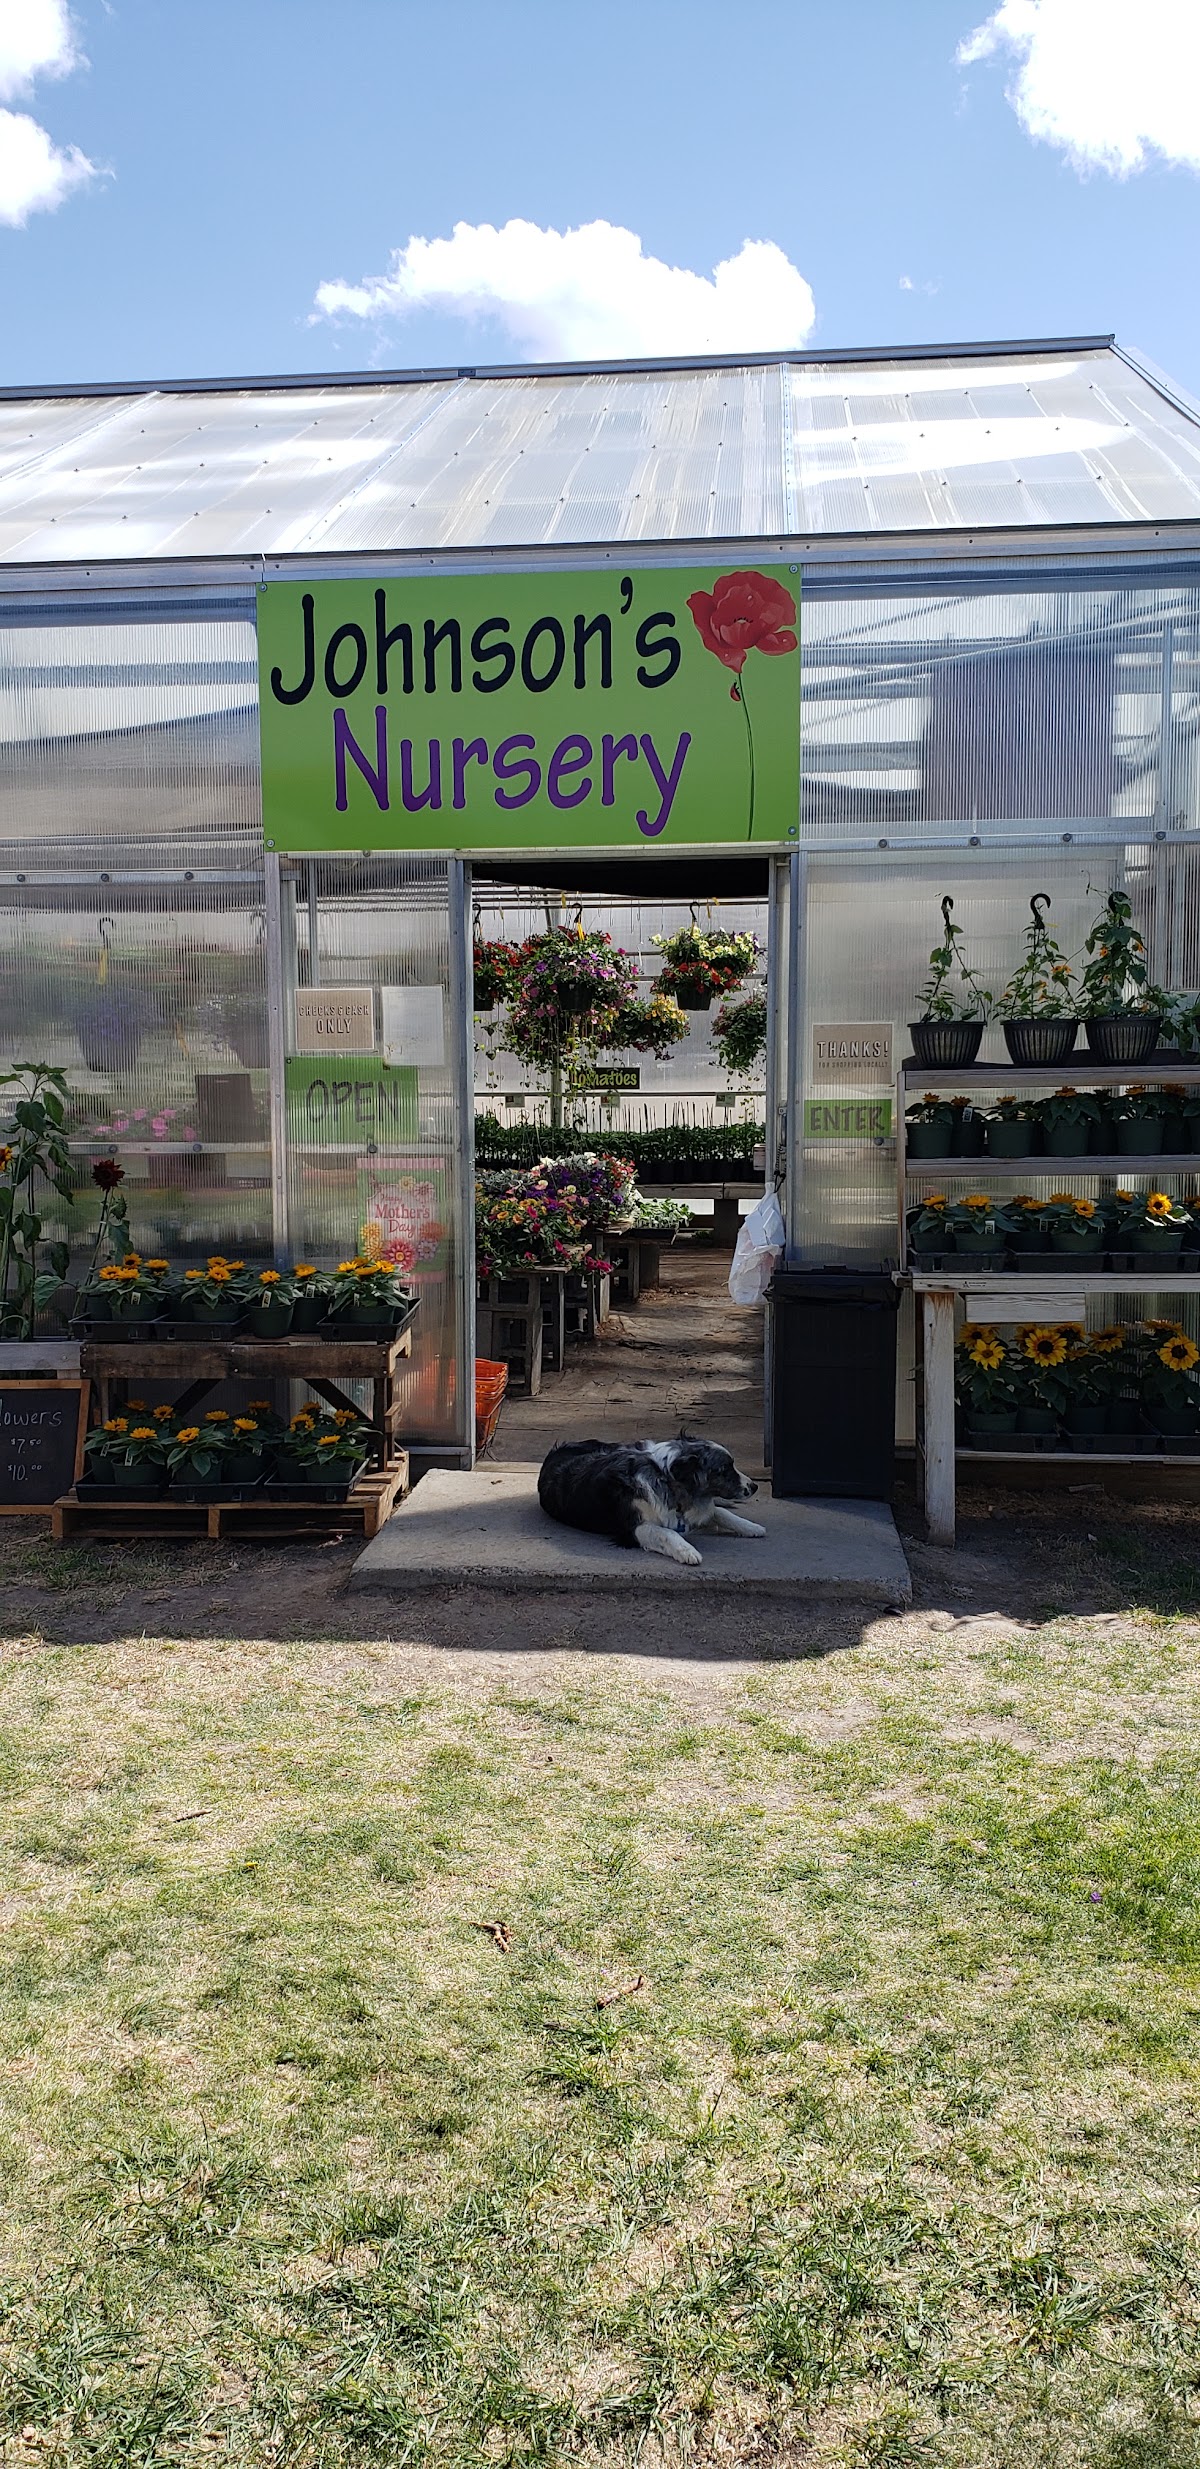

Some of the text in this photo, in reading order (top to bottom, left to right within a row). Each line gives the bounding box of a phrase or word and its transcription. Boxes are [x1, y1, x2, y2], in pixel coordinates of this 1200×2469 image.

[270, 576, 682, 705] Johnson's
[332, 705, 692, 837] Nursery
[299, 1005, 335, 1016] CHECKS
[345, 1005, 369, 1016] CASH
[316, 1018, 352, 1034] ONLY
[817, 1041, 889, 1058] THANKS!
[306, 1079, 398, 1123] OPEN
[810, 1105, 885, 1131] ENTER
[375, 1204, 430, 1219] Mother's
[389, 1219, 416, 1238] Day
